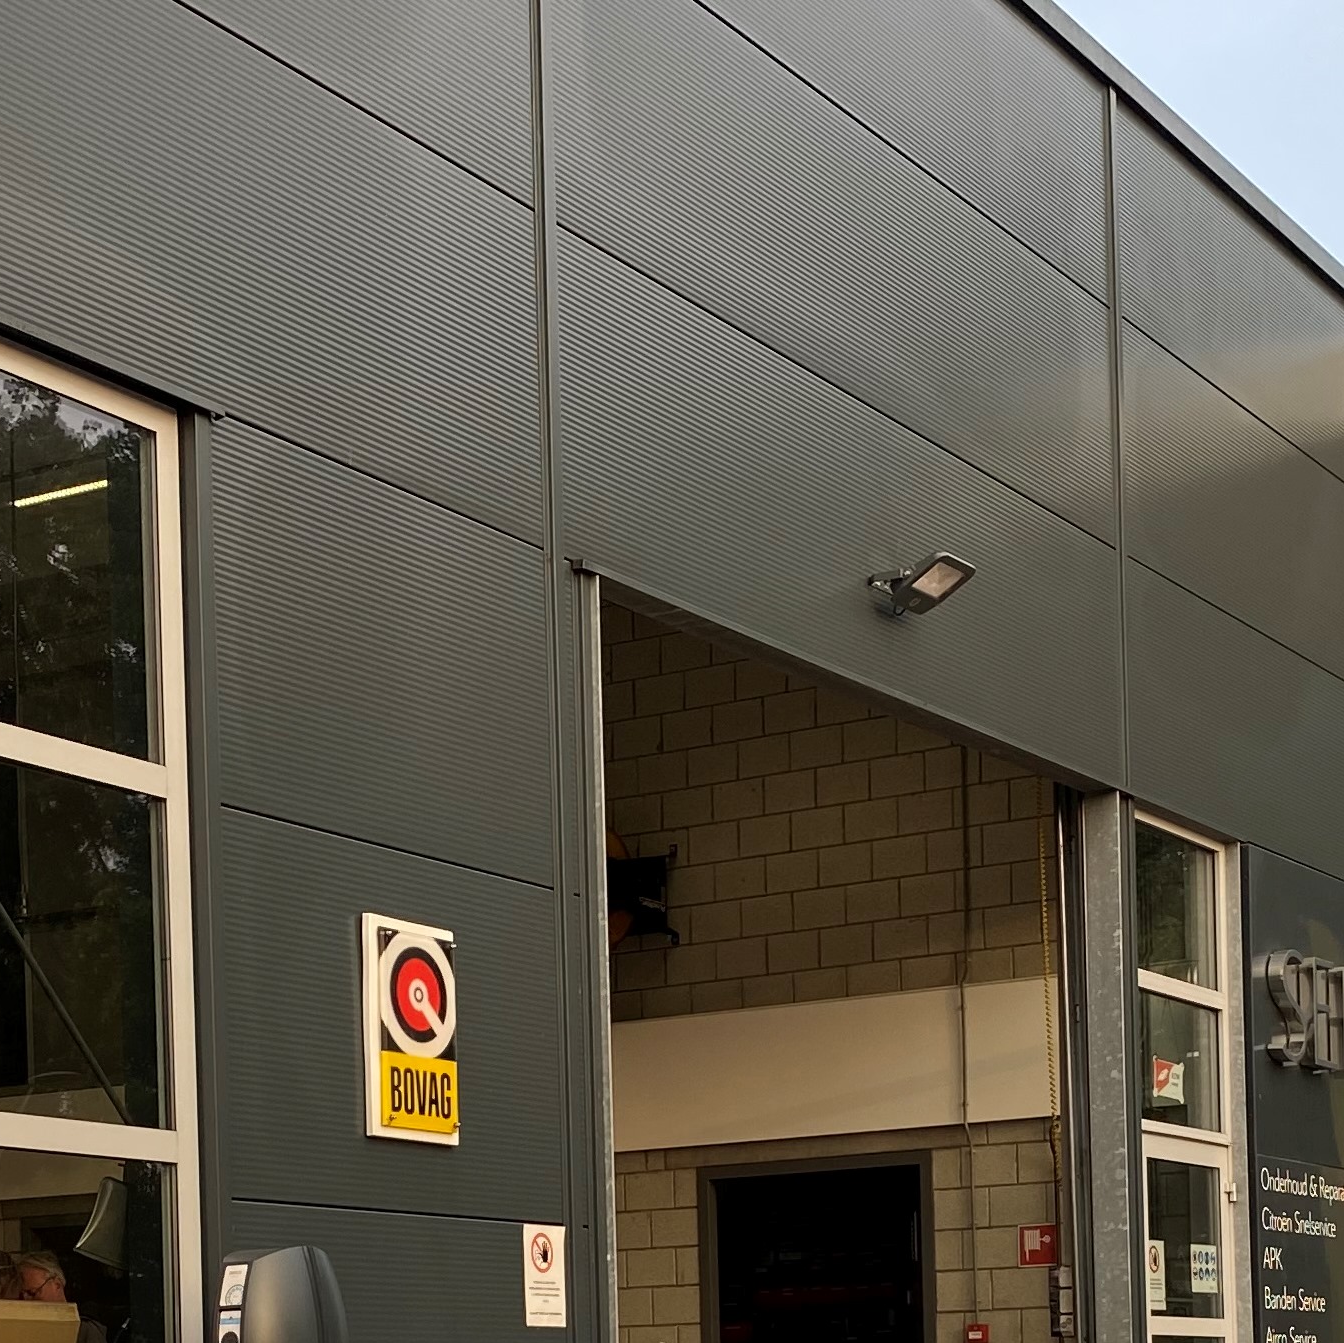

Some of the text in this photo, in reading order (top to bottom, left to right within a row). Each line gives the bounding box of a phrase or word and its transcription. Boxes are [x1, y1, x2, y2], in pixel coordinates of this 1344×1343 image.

[390, 1066, 451, 1119] BOVAG
[1260, 1167, 1308, 1196] Onderhoud
[1309, 1175, 1318, 1197] &
[1261, 1206, 1337, 1238] Citroën Snelservice
[1263, 1246, 1284, 1270] APK
[1264, 1285, 1326, 1312] Banden Service
